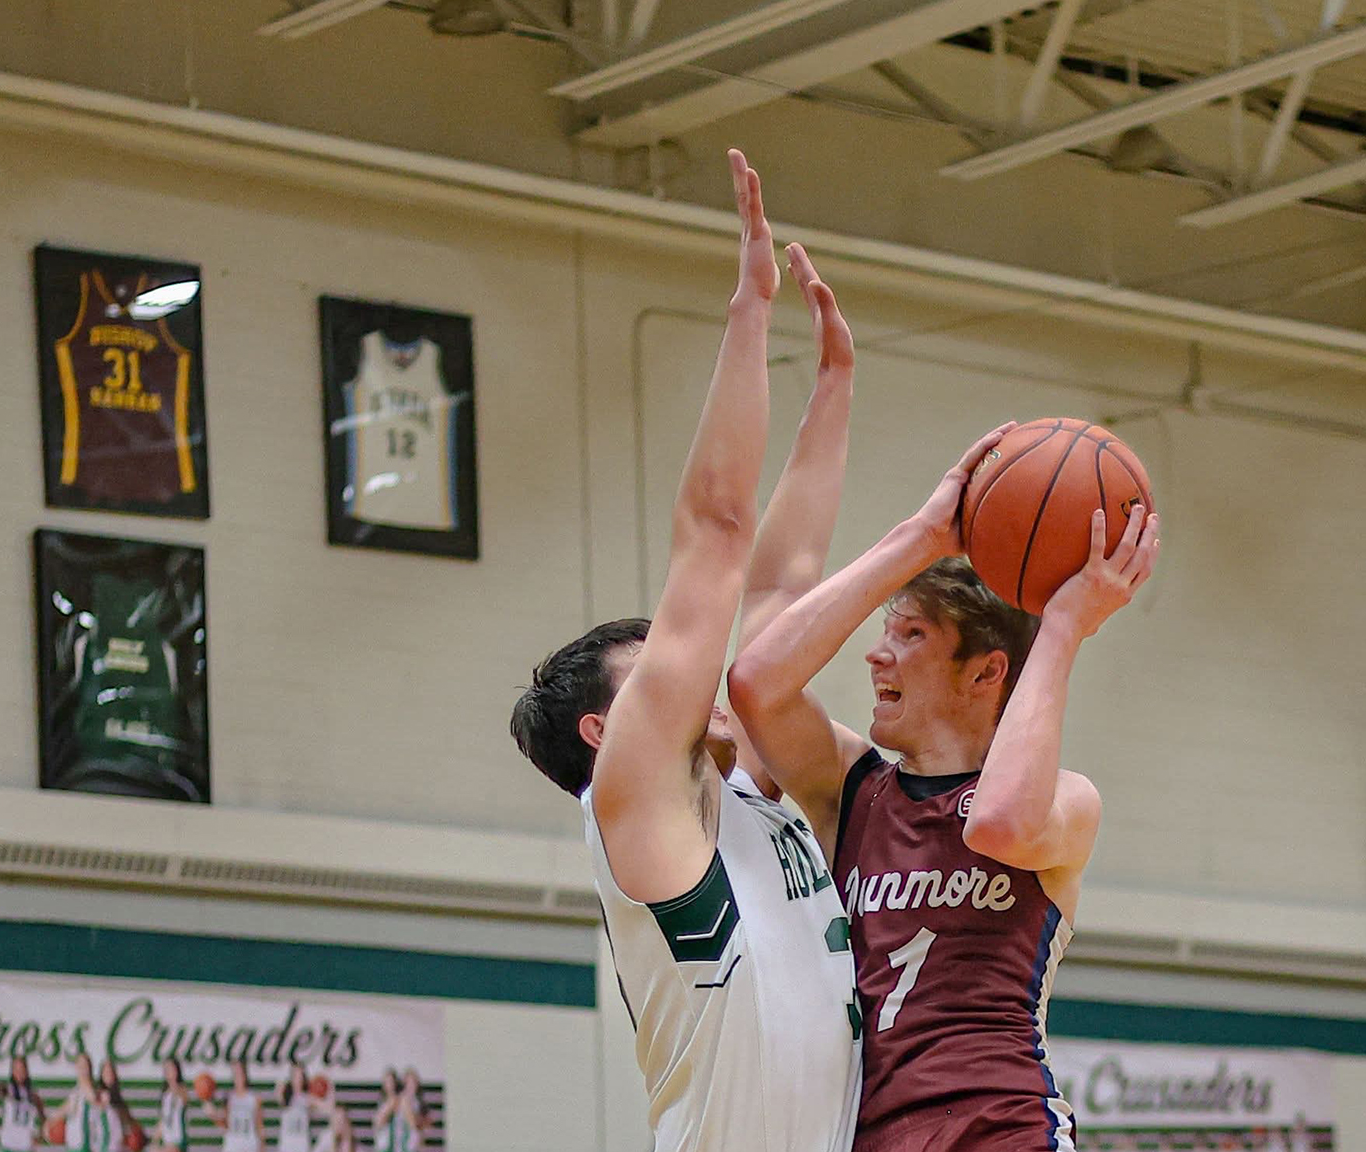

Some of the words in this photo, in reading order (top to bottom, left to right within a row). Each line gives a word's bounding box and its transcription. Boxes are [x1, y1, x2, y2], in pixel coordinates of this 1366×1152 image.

[104, 348, 141, 391] 31
[877, 926, 937, 1032] 1
[107, 998, 359, 1067] Crusaders
